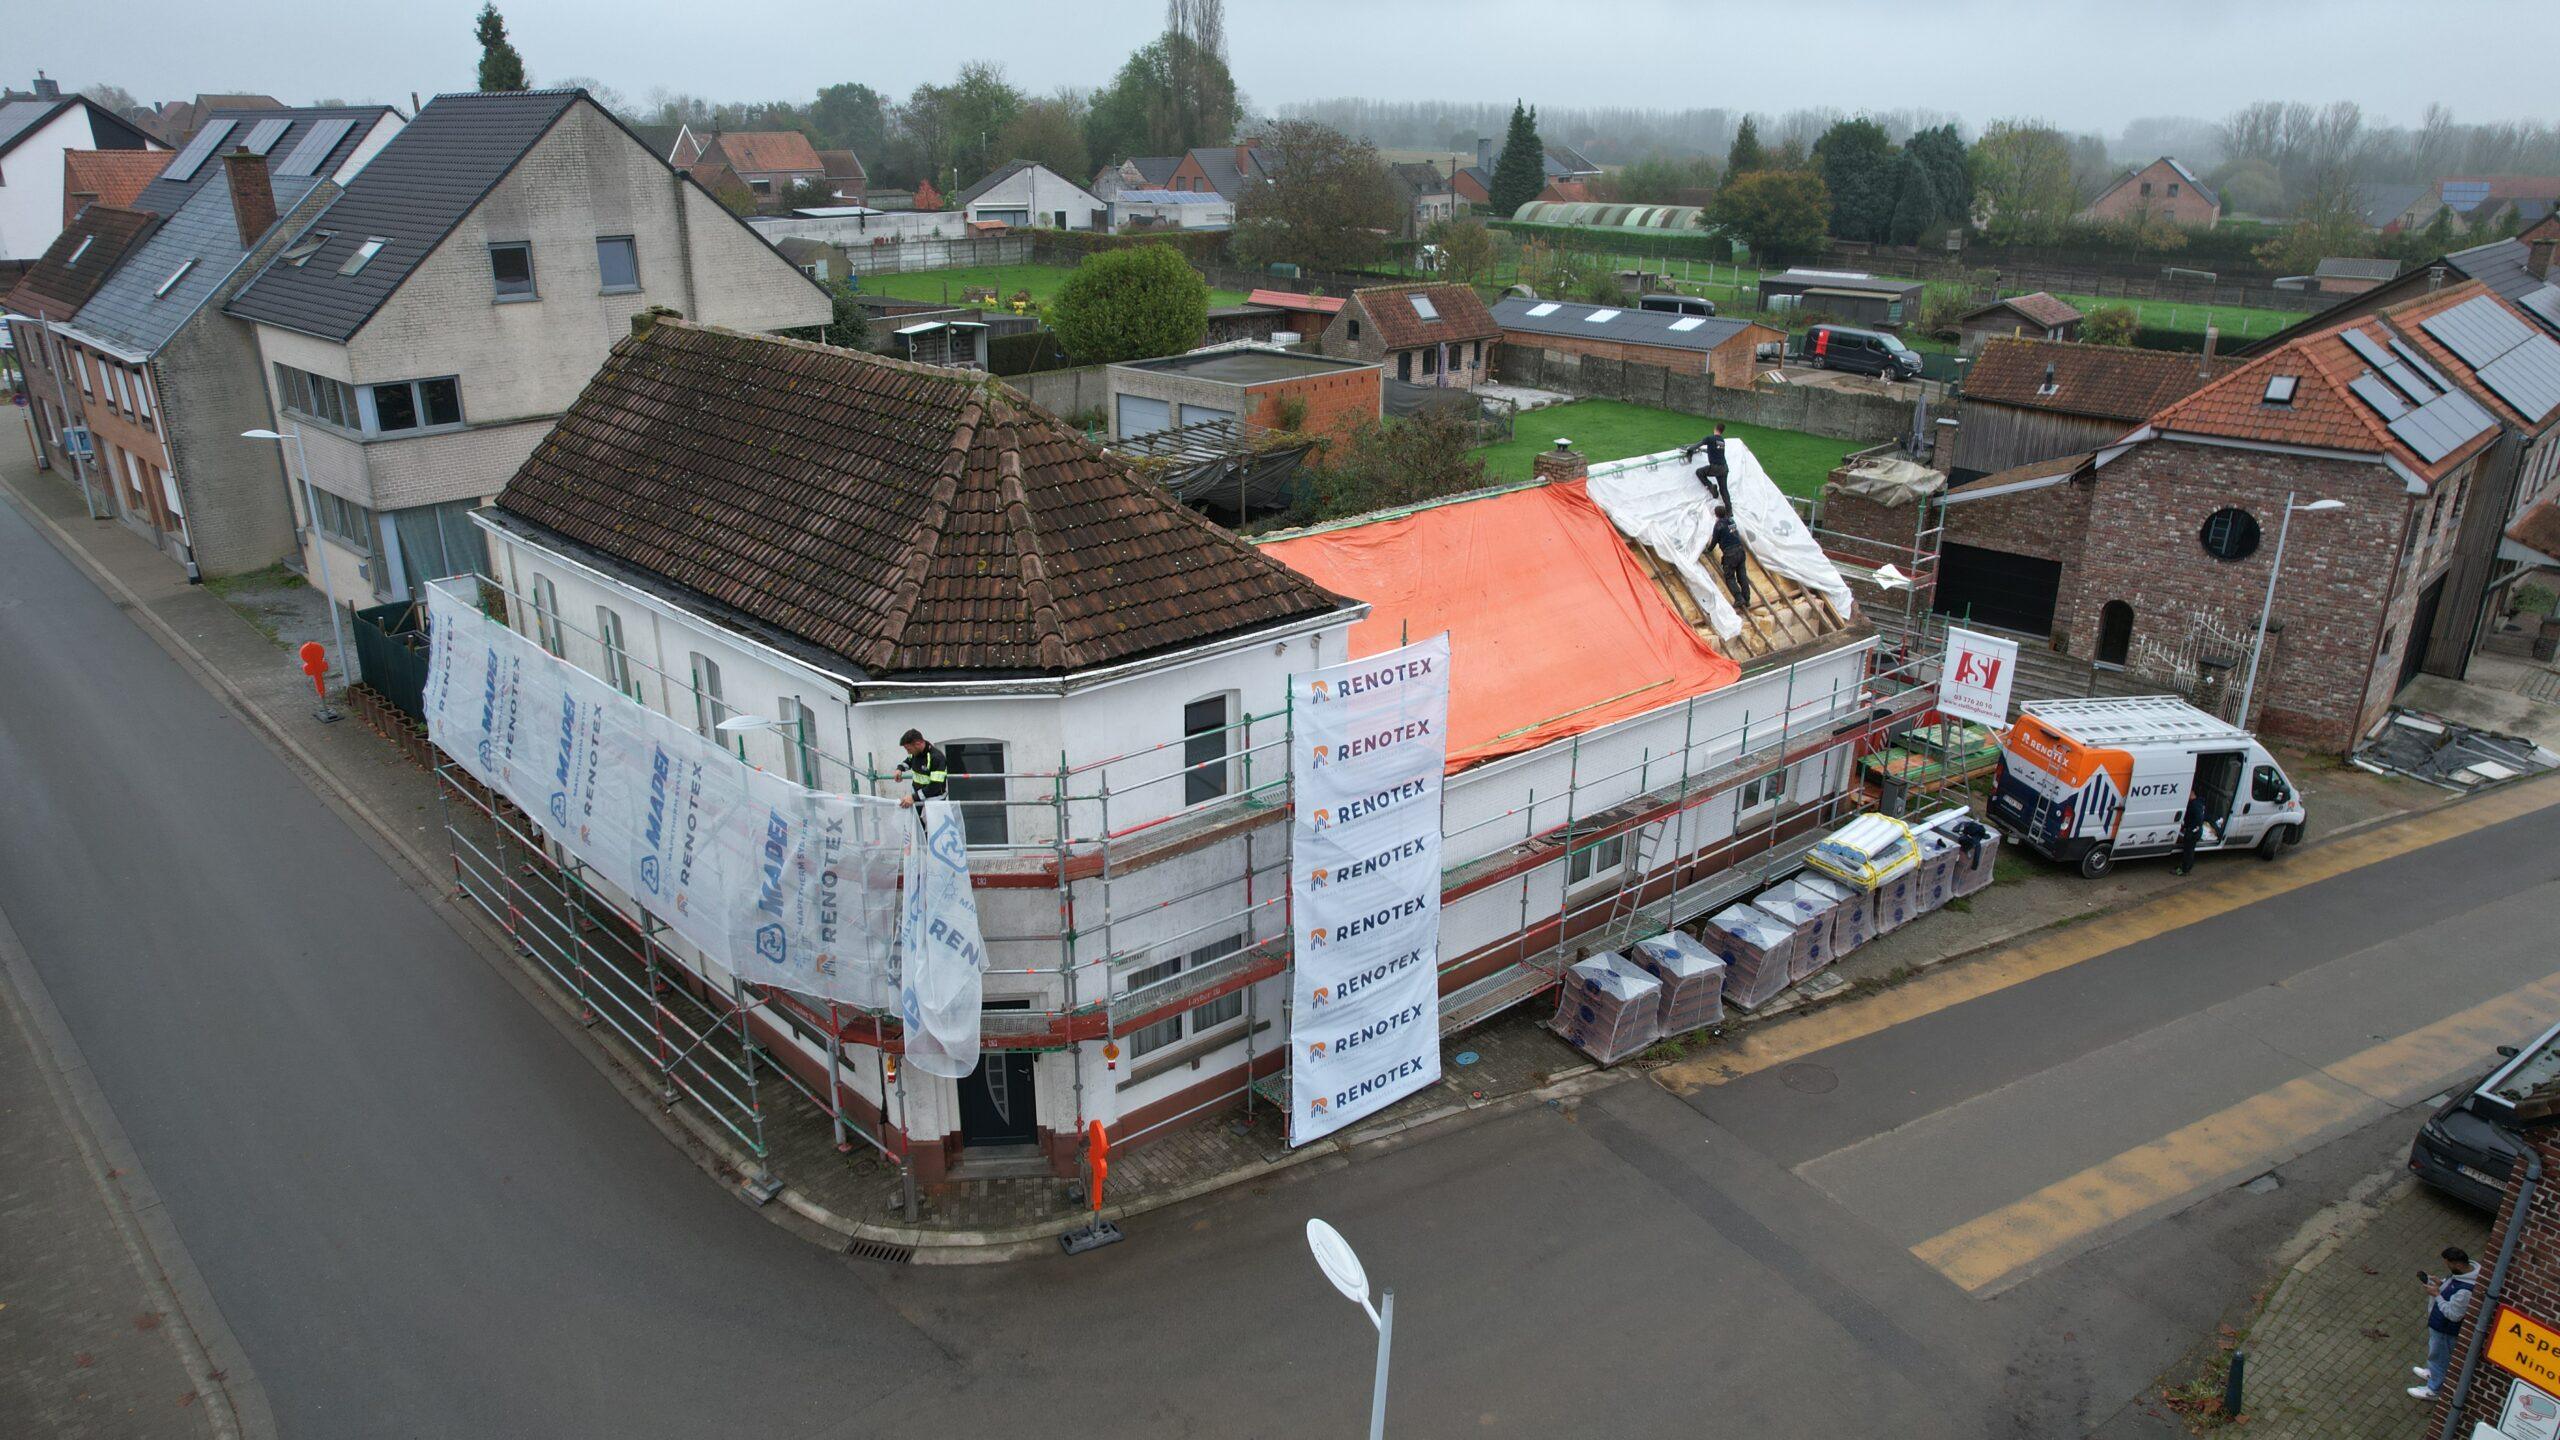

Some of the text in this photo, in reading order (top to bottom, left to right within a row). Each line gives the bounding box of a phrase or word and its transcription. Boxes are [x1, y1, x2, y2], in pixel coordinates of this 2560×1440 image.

[439, 615, 454, 713] RENOTEX
[1337, 657, 1432, 698] RENOTEX
[1954, 650, 2002, 691] ASV
[505, 655, 521, 760] RENOTEX
[555, 691, 577, 788] MAPEI
[583, 703, 603, 818] RENOTEX
[1338, 719, 1430, 761] RENOTEX
[2030, 738, 2071, 768] RENOTEX
[645, 744, 670, 852] MAPEI
[1338, 778, 1425, 824] RENOTEX
[2130, 783, 2179, 798] NOTEX
[680, 761, 703, 887] RENOTEX
[758, 810, 789, 918] MAPEI
[820, 817, 843, 945] RENOTEX
[1336, 836, 1425, 883] RENOTEX
[798, 861, 808, 927] MAPETHERM
[1336, 894, 1426, 942] RENOTEX
[929, 918, 980, 966] REN
[1336, 948, 1421, 1000] RENOTEX
[1335, 1003, 1423, 1053] RENOTEX
[1336, 1056, 1423, 1109] RENOTEX
[2515, 1351, 2560, 1385] Nino
